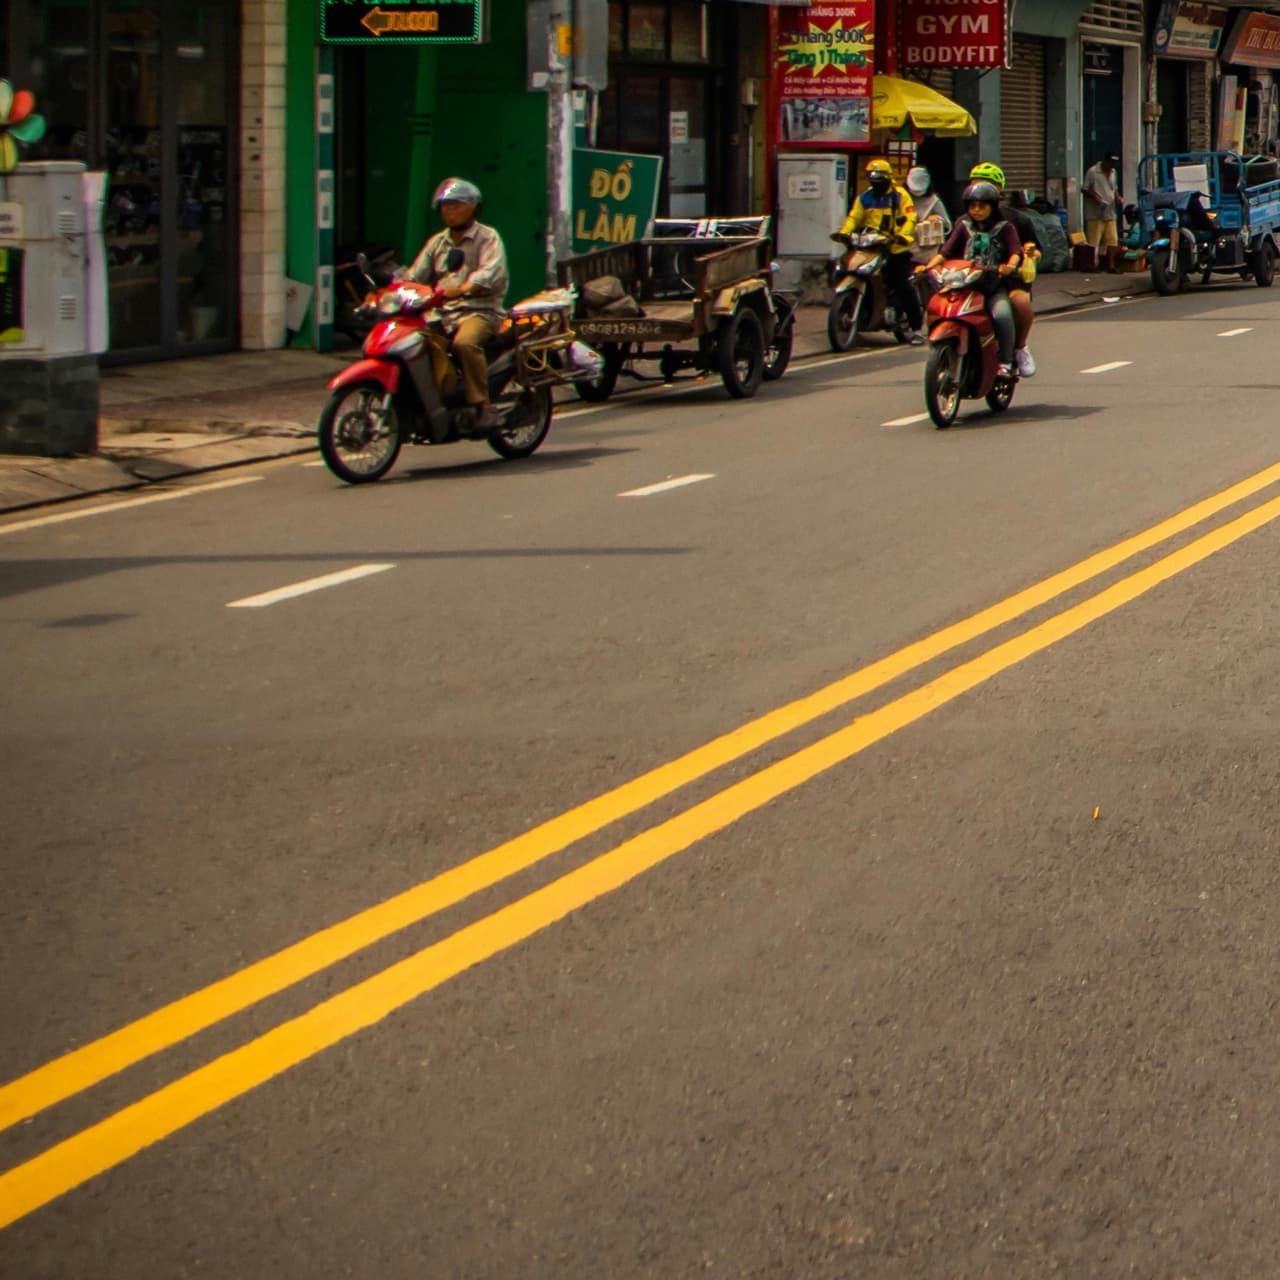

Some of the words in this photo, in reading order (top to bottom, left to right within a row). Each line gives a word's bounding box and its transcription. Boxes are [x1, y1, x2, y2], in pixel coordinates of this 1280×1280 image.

[916, 14, 989, 34] GYM
[907, 45, 999, 63] BODYFIT
[589, 159, 633, 202] ĐỒ
[575, 203, 637, 243] LÀM
